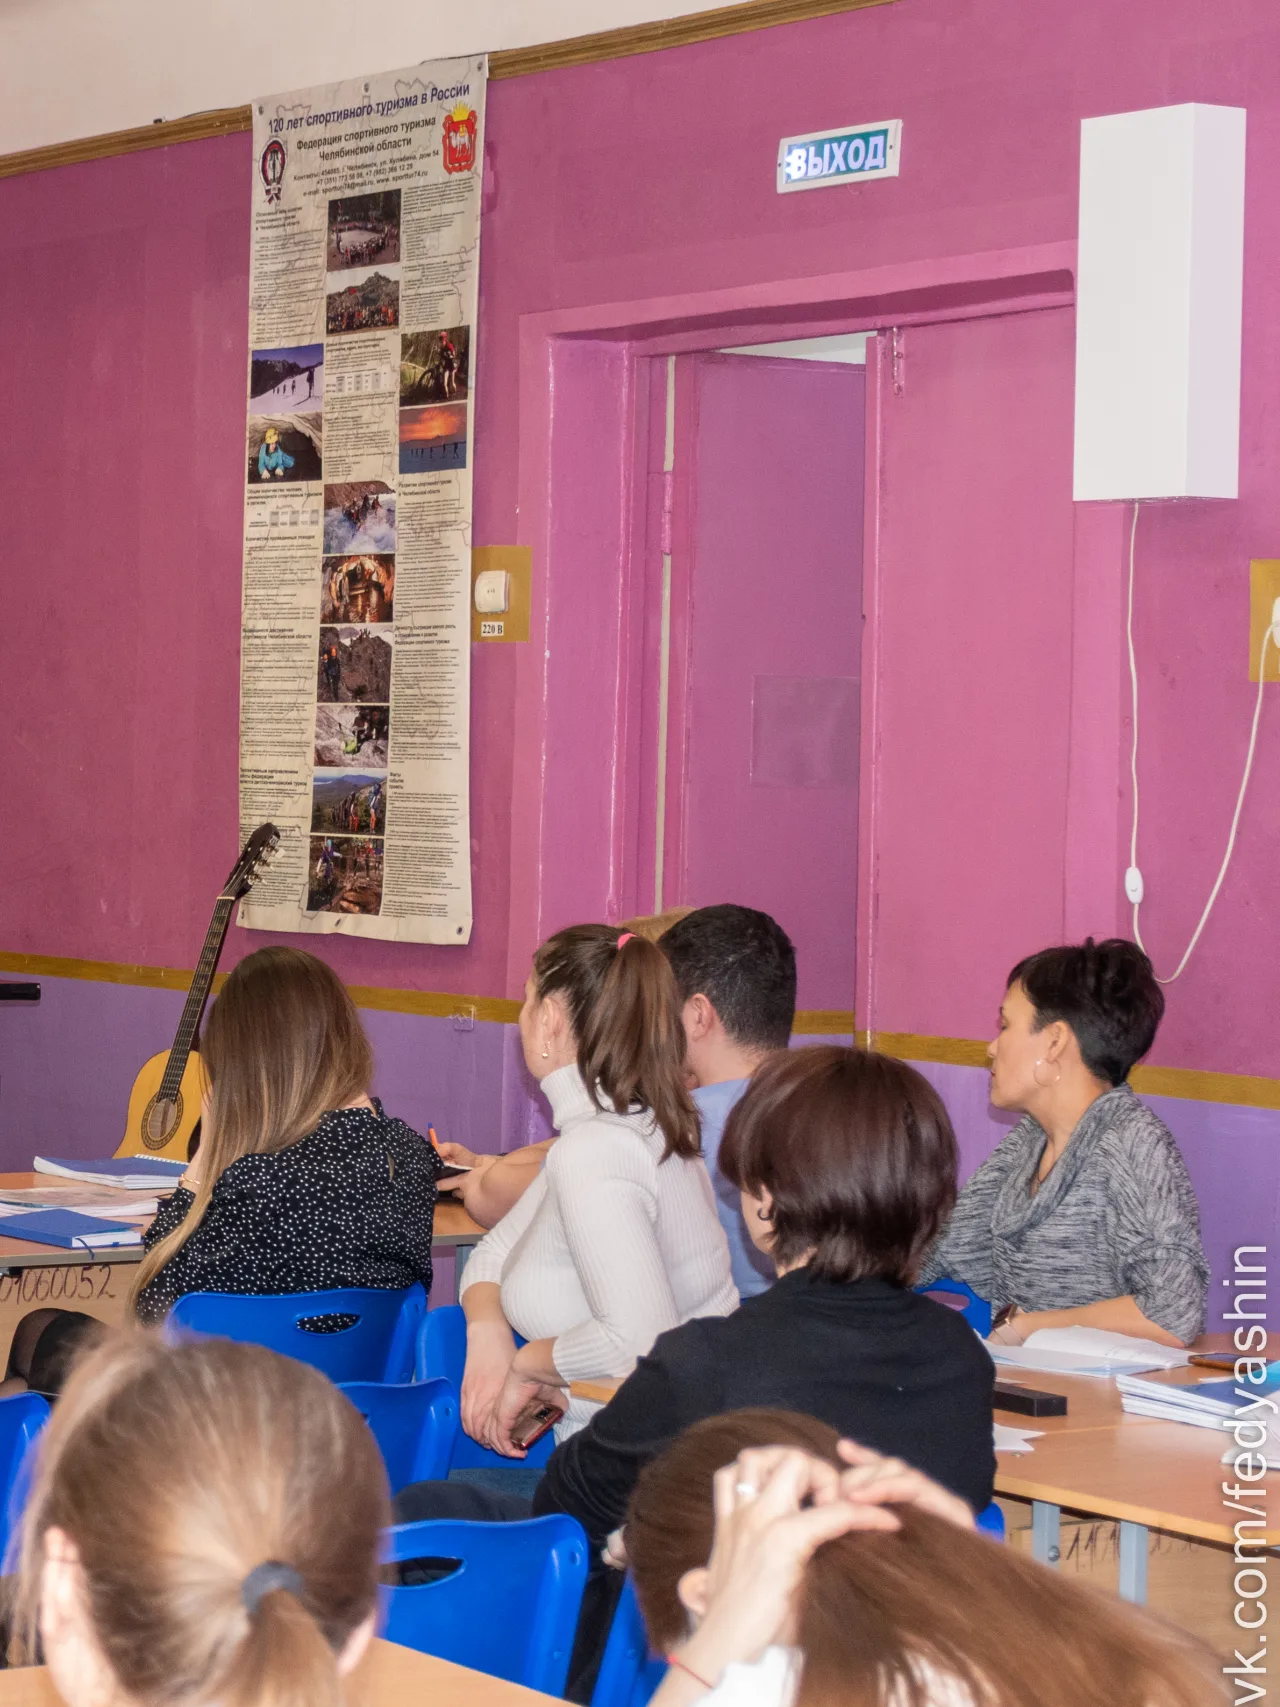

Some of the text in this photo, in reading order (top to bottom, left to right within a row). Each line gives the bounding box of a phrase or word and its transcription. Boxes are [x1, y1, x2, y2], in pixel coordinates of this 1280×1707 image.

[269, 84, 470, 133] 120 лет спортивного туризма в России
[297, 117, 436, 150] Федерация спортивного туризма
[319, 138, 412, 161] Челябинской области
[788, 135, 885, 180] ВЫХОД
[482, 624, 503, 634] 220 В
